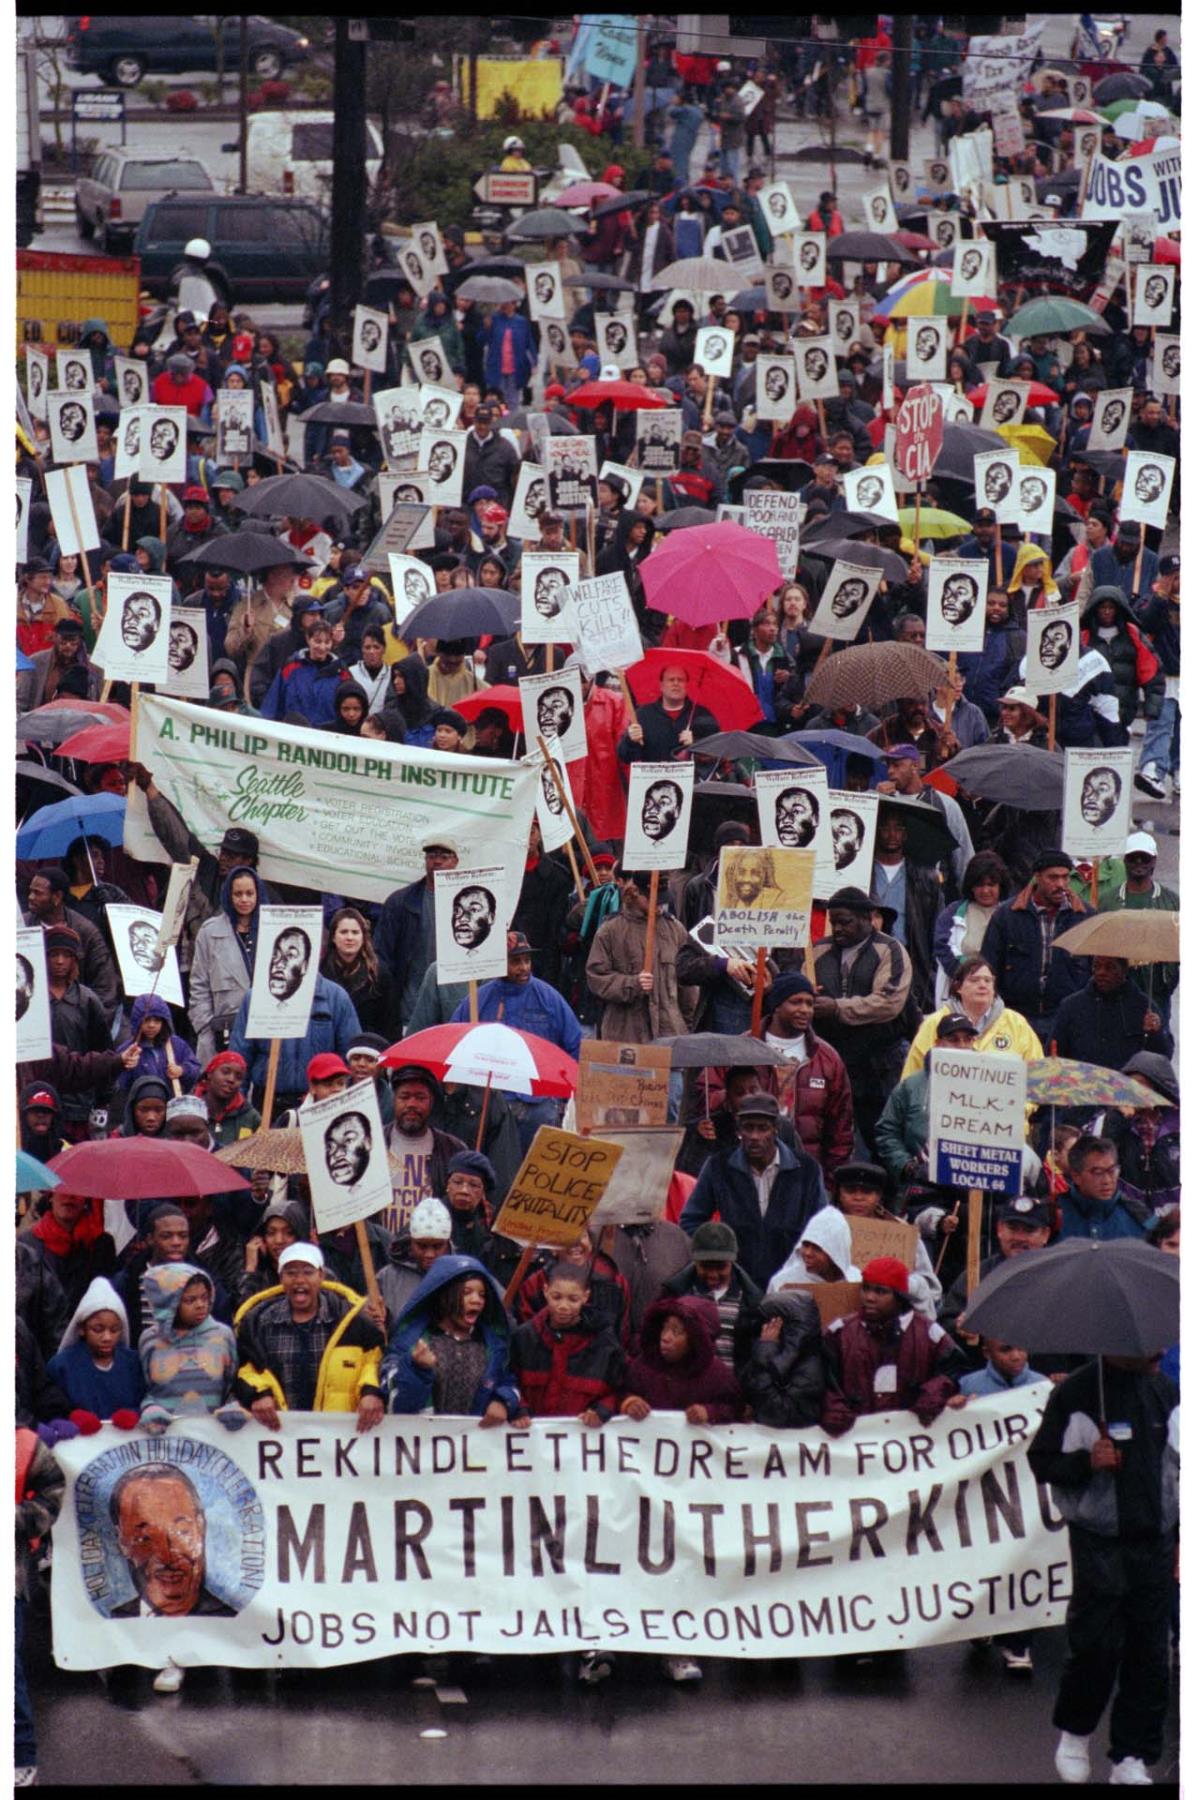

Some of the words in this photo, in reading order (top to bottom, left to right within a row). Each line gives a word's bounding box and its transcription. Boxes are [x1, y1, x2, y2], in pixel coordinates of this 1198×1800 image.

[1086, 160, 1146, 208] JOBS
[901, 393, 939, 433] STOP
[905, 440, 932, 479] CIA
[748, 494, 798, 509] DEFEND
[570, 575, 622, 602] WELFARE
[578, 595, 623, 618] CUTS
[159, 717, 180, 741] A.
[190, 722, 268, 756] PHILIP
[277, 741, 392, 781] RANDOLPH
[401, 764, 515, 801] INSTITUTE
[230, 764, 306, 799] Seattle
[228, 794, 309, 826] Chapter
[717, 922, 757, 935] Death
[719, 910, 779, 922] ABOLISH
[785, 912, 806, 921] the
[941, 1114, 1013, 1137] DREAM
[541, 1141, 607, 1172] STOP
[941, 1141, 978, 1159] SHEET
[981, 1147, 1019, 1163] METAL
[950, 1157, 1009, 1177] WORKERS
[519, 1164, 602, 1200] POLICE
[952, 1172, 990, 1190] LOCAL
[855, 1435, 935, 1476] FOR
[948, 1414, 1029, 1460] OUR
[276, 1495, 567, 1583] MARTIN
[584, 1494, 889, 1577] LUTHER
[262, 1608, 376, 1648] JOBS
[393, 1611, 481, 1641] NOT
[500, 1607, 629, 1640] JAILS
[640, 1594, 876, 1641] ECONOMIC
[888, 1561, 1072, 1626] JUSTICE
